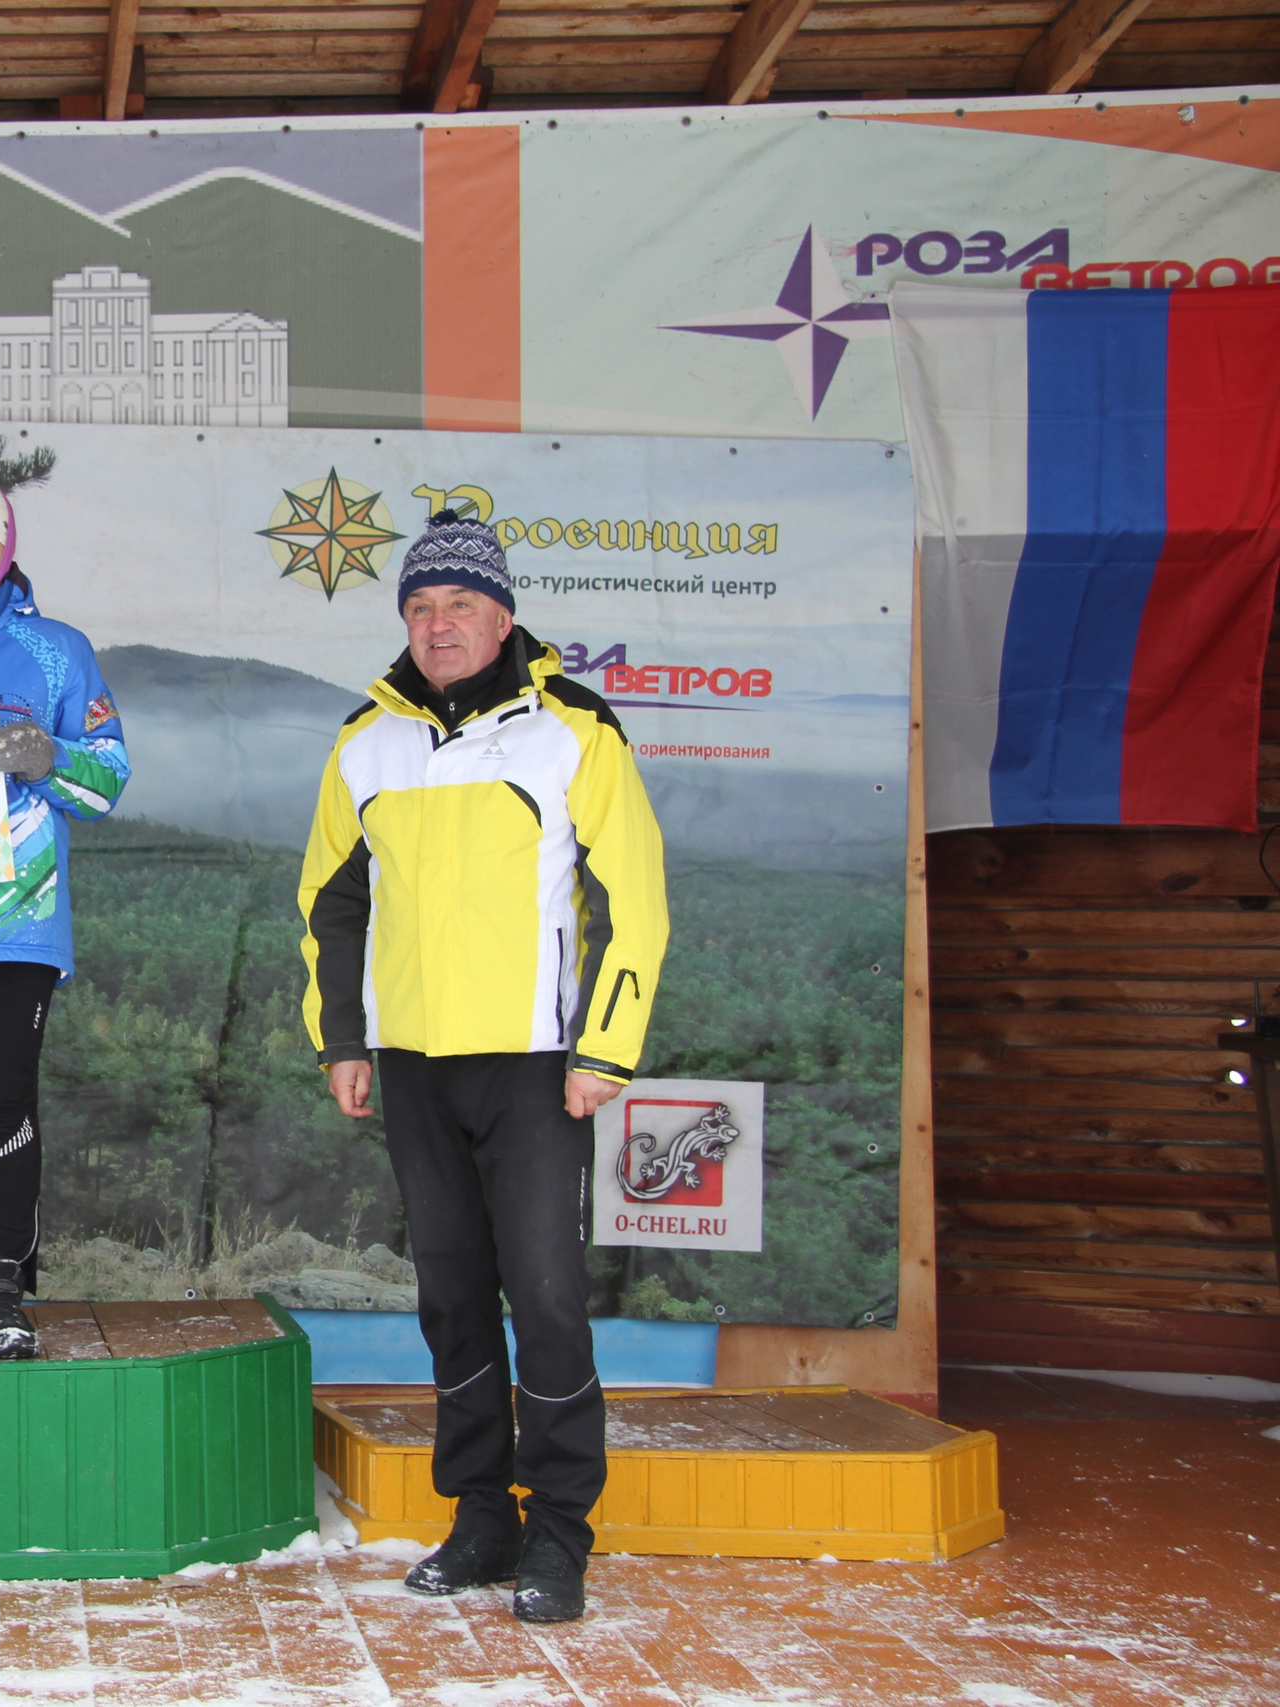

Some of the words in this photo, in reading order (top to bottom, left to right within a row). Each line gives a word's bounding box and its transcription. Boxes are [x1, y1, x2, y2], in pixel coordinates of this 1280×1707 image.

[856, 228, 1069, 276] РОЗА
[711, 580, 777, 598] центр
[542, 641, 627, 674] ЗА
[603, 664, 773, 697] ВЕТРОВ
[639, 743, 770, 761] ориентирования
[614, 1214, 728, 1236] O-CHEL.RU
